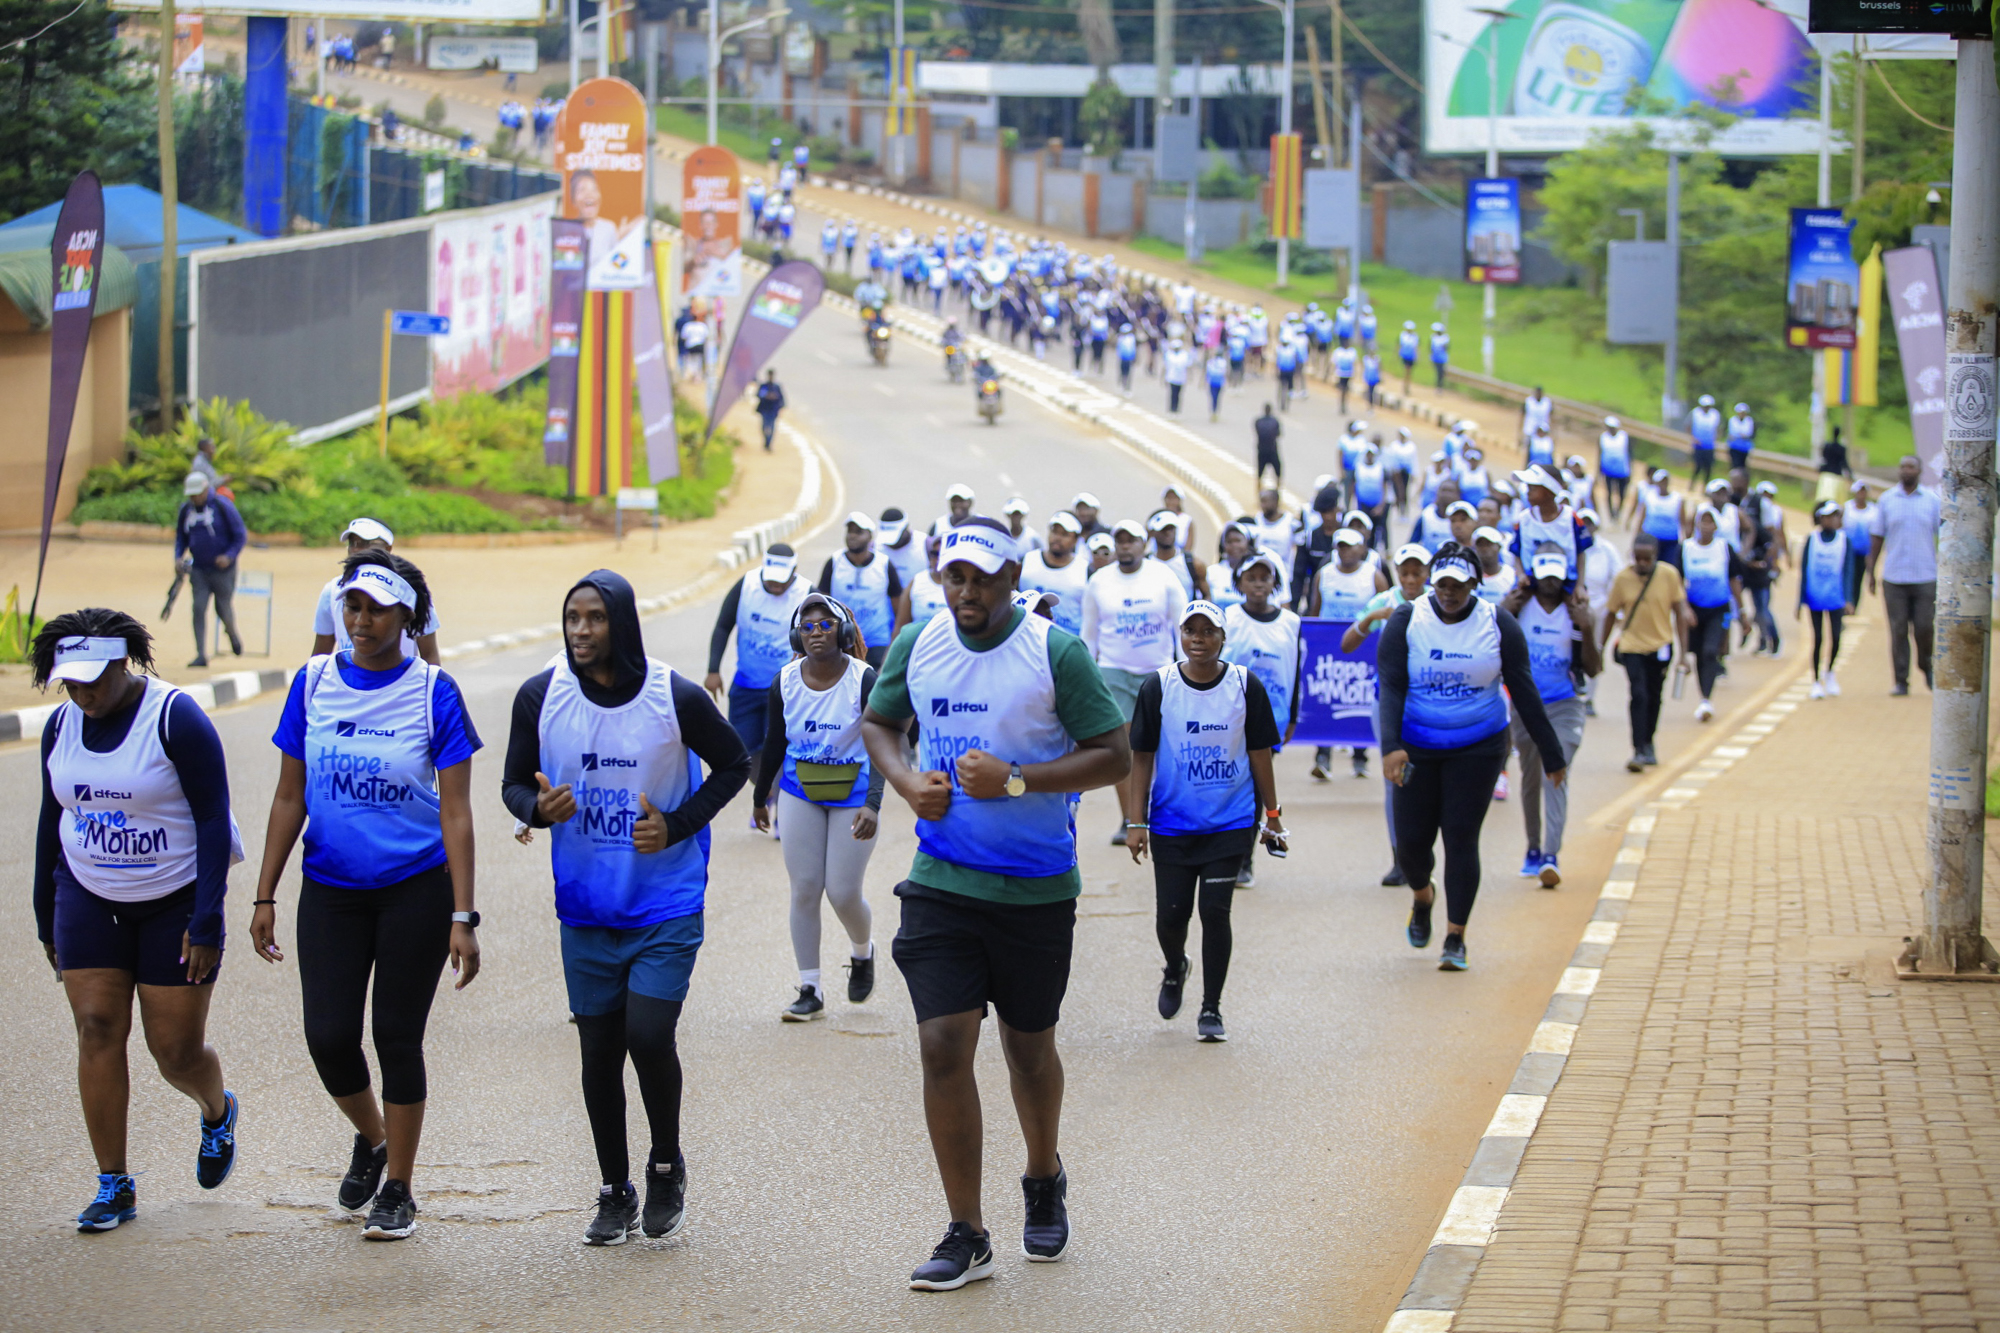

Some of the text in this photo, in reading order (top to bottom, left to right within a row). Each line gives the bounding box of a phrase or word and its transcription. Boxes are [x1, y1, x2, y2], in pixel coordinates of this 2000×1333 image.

[1859, 1, 1901, 10] brussels
[1526, 66, 1623, 116] LITE
[579, 122, 631, 140] FAMILY
[565, 152, 643, 172] STARTIMES
[958, 534, 995, 550] dfcu
[361, 571, 394, 587] dfcu
[1315, 653, 1369, 685] Hope
[1420, 666, 1465, 684] Hope
[951, 702, 988, 712] dfcu
[357, 728, 396, 737] dfcu
[927, 727, 982, 759] Hope
[1180, 740, 1222, 764] Hope
[318, 745, 382, 779] Hope
[600, 757, 638, 768] dfcu
[94, 789, 133, 800] dfcu
[575, 780, 630, 814] Hope
[583, 806, 638, 838] Moti
[90, 853, 107, 862] WALK
